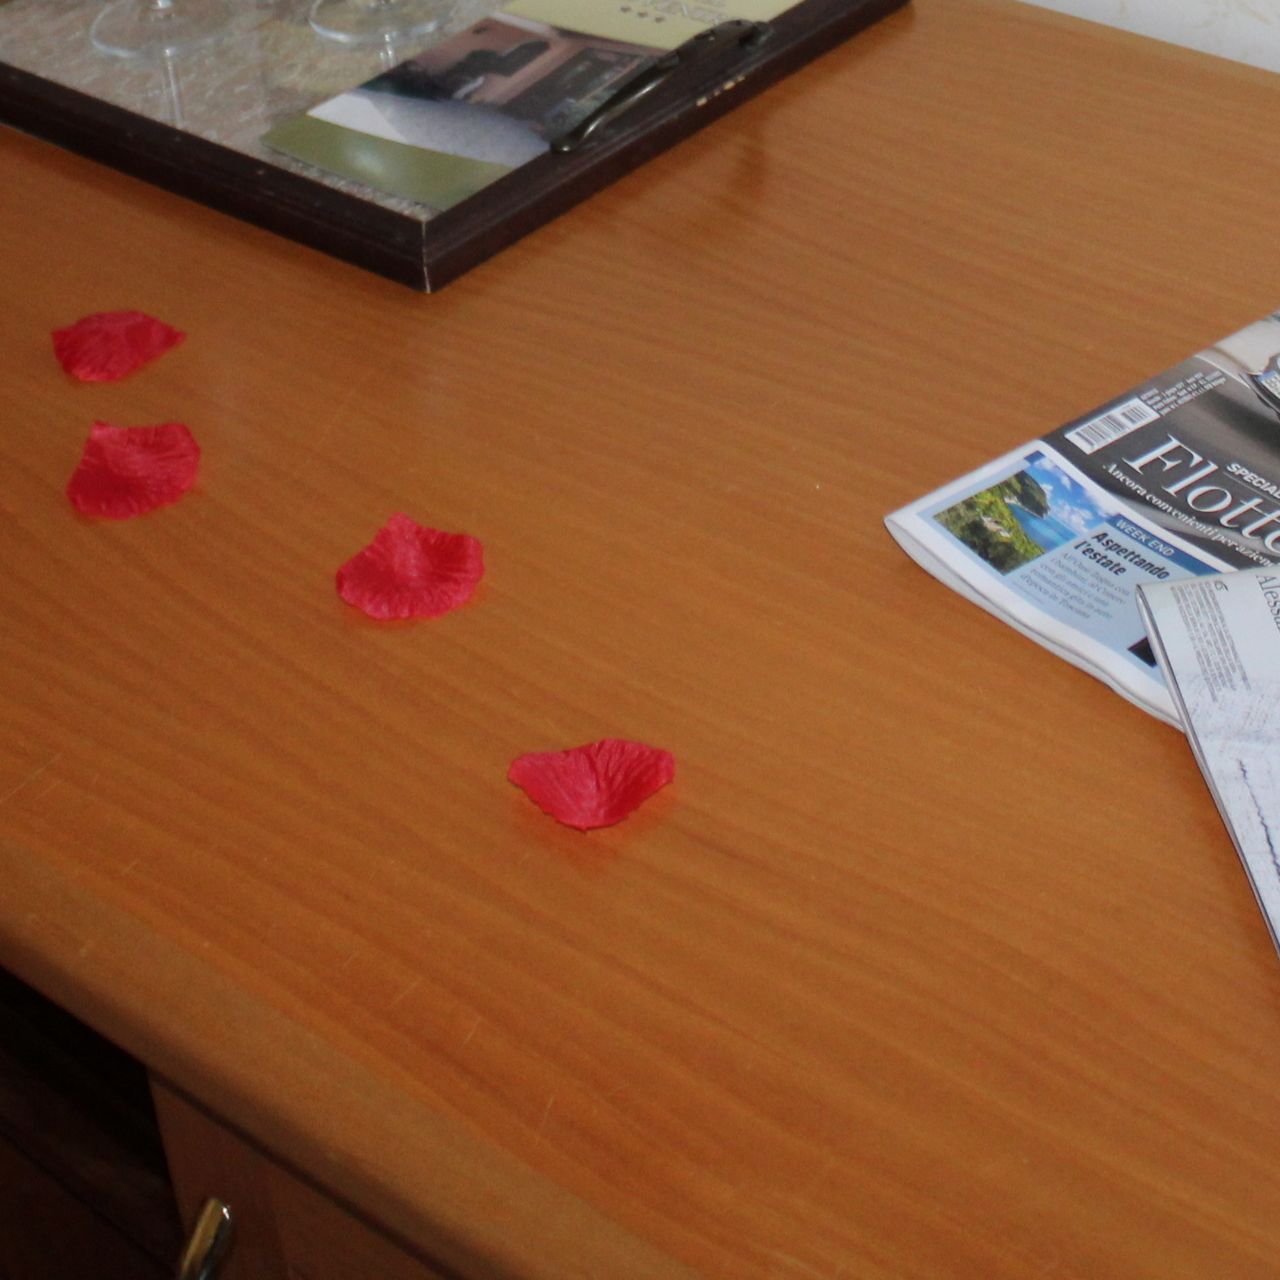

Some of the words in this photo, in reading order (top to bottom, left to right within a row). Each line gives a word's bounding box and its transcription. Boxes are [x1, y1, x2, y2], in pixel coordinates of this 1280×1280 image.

[1102, 462, 1148, 501] Ancora
[1145, 493, 1215, 538] convenienti
[1211, 531, 1239, 554] per
[1073, 539, 1127, 577] l'estate
[1091, 531, 1171, 581] Aspettando
[1116, 519, 1152, 544] WEEK
[1147, 537, 1176, 557] END
